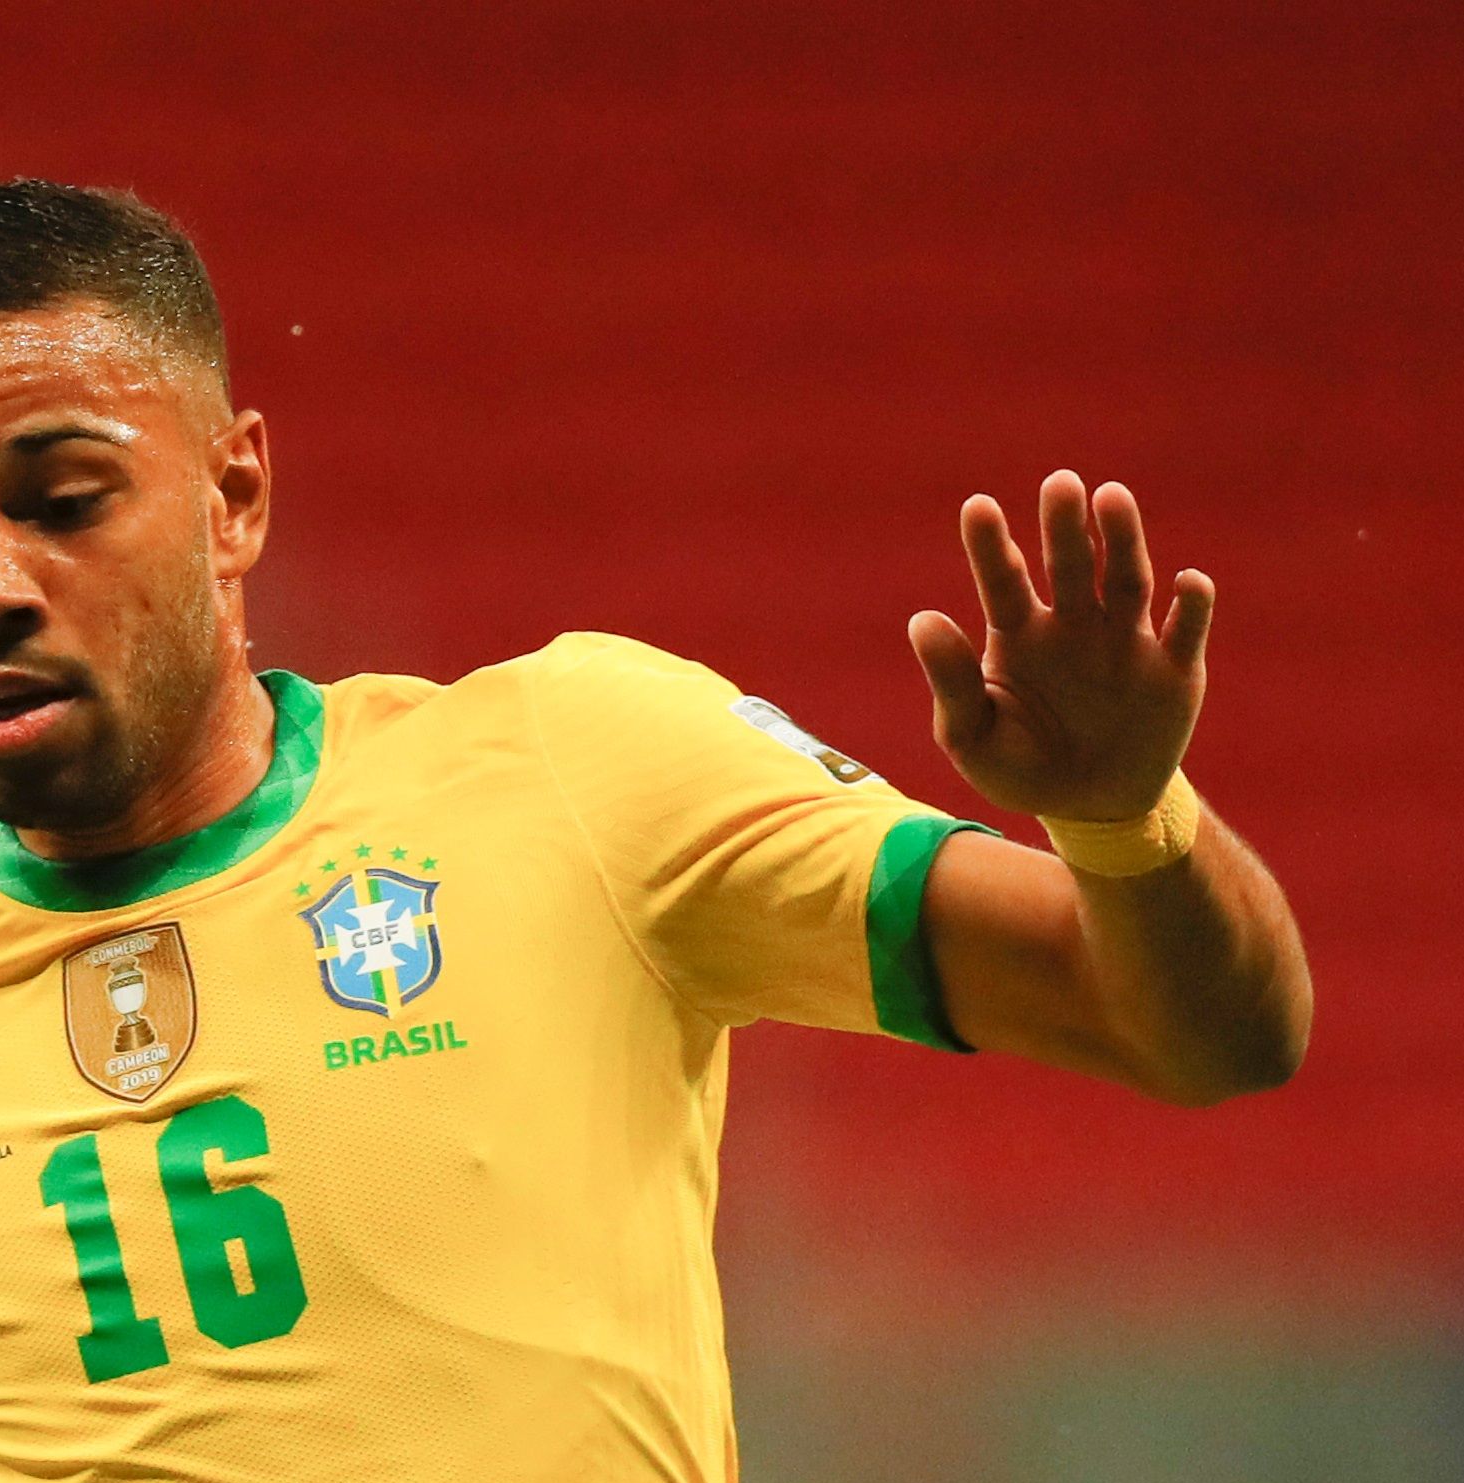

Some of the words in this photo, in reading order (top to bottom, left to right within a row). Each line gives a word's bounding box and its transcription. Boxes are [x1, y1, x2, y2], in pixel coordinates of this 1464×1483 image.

[351, 923, 399, 949] CBF
[89, 937, 153, 966] CONMEBOL
[323, 1020, 468, 1071] BRASIL
[120, 1067, 160, 1091] 2019
[38, 1093, 309, 1385] 16
